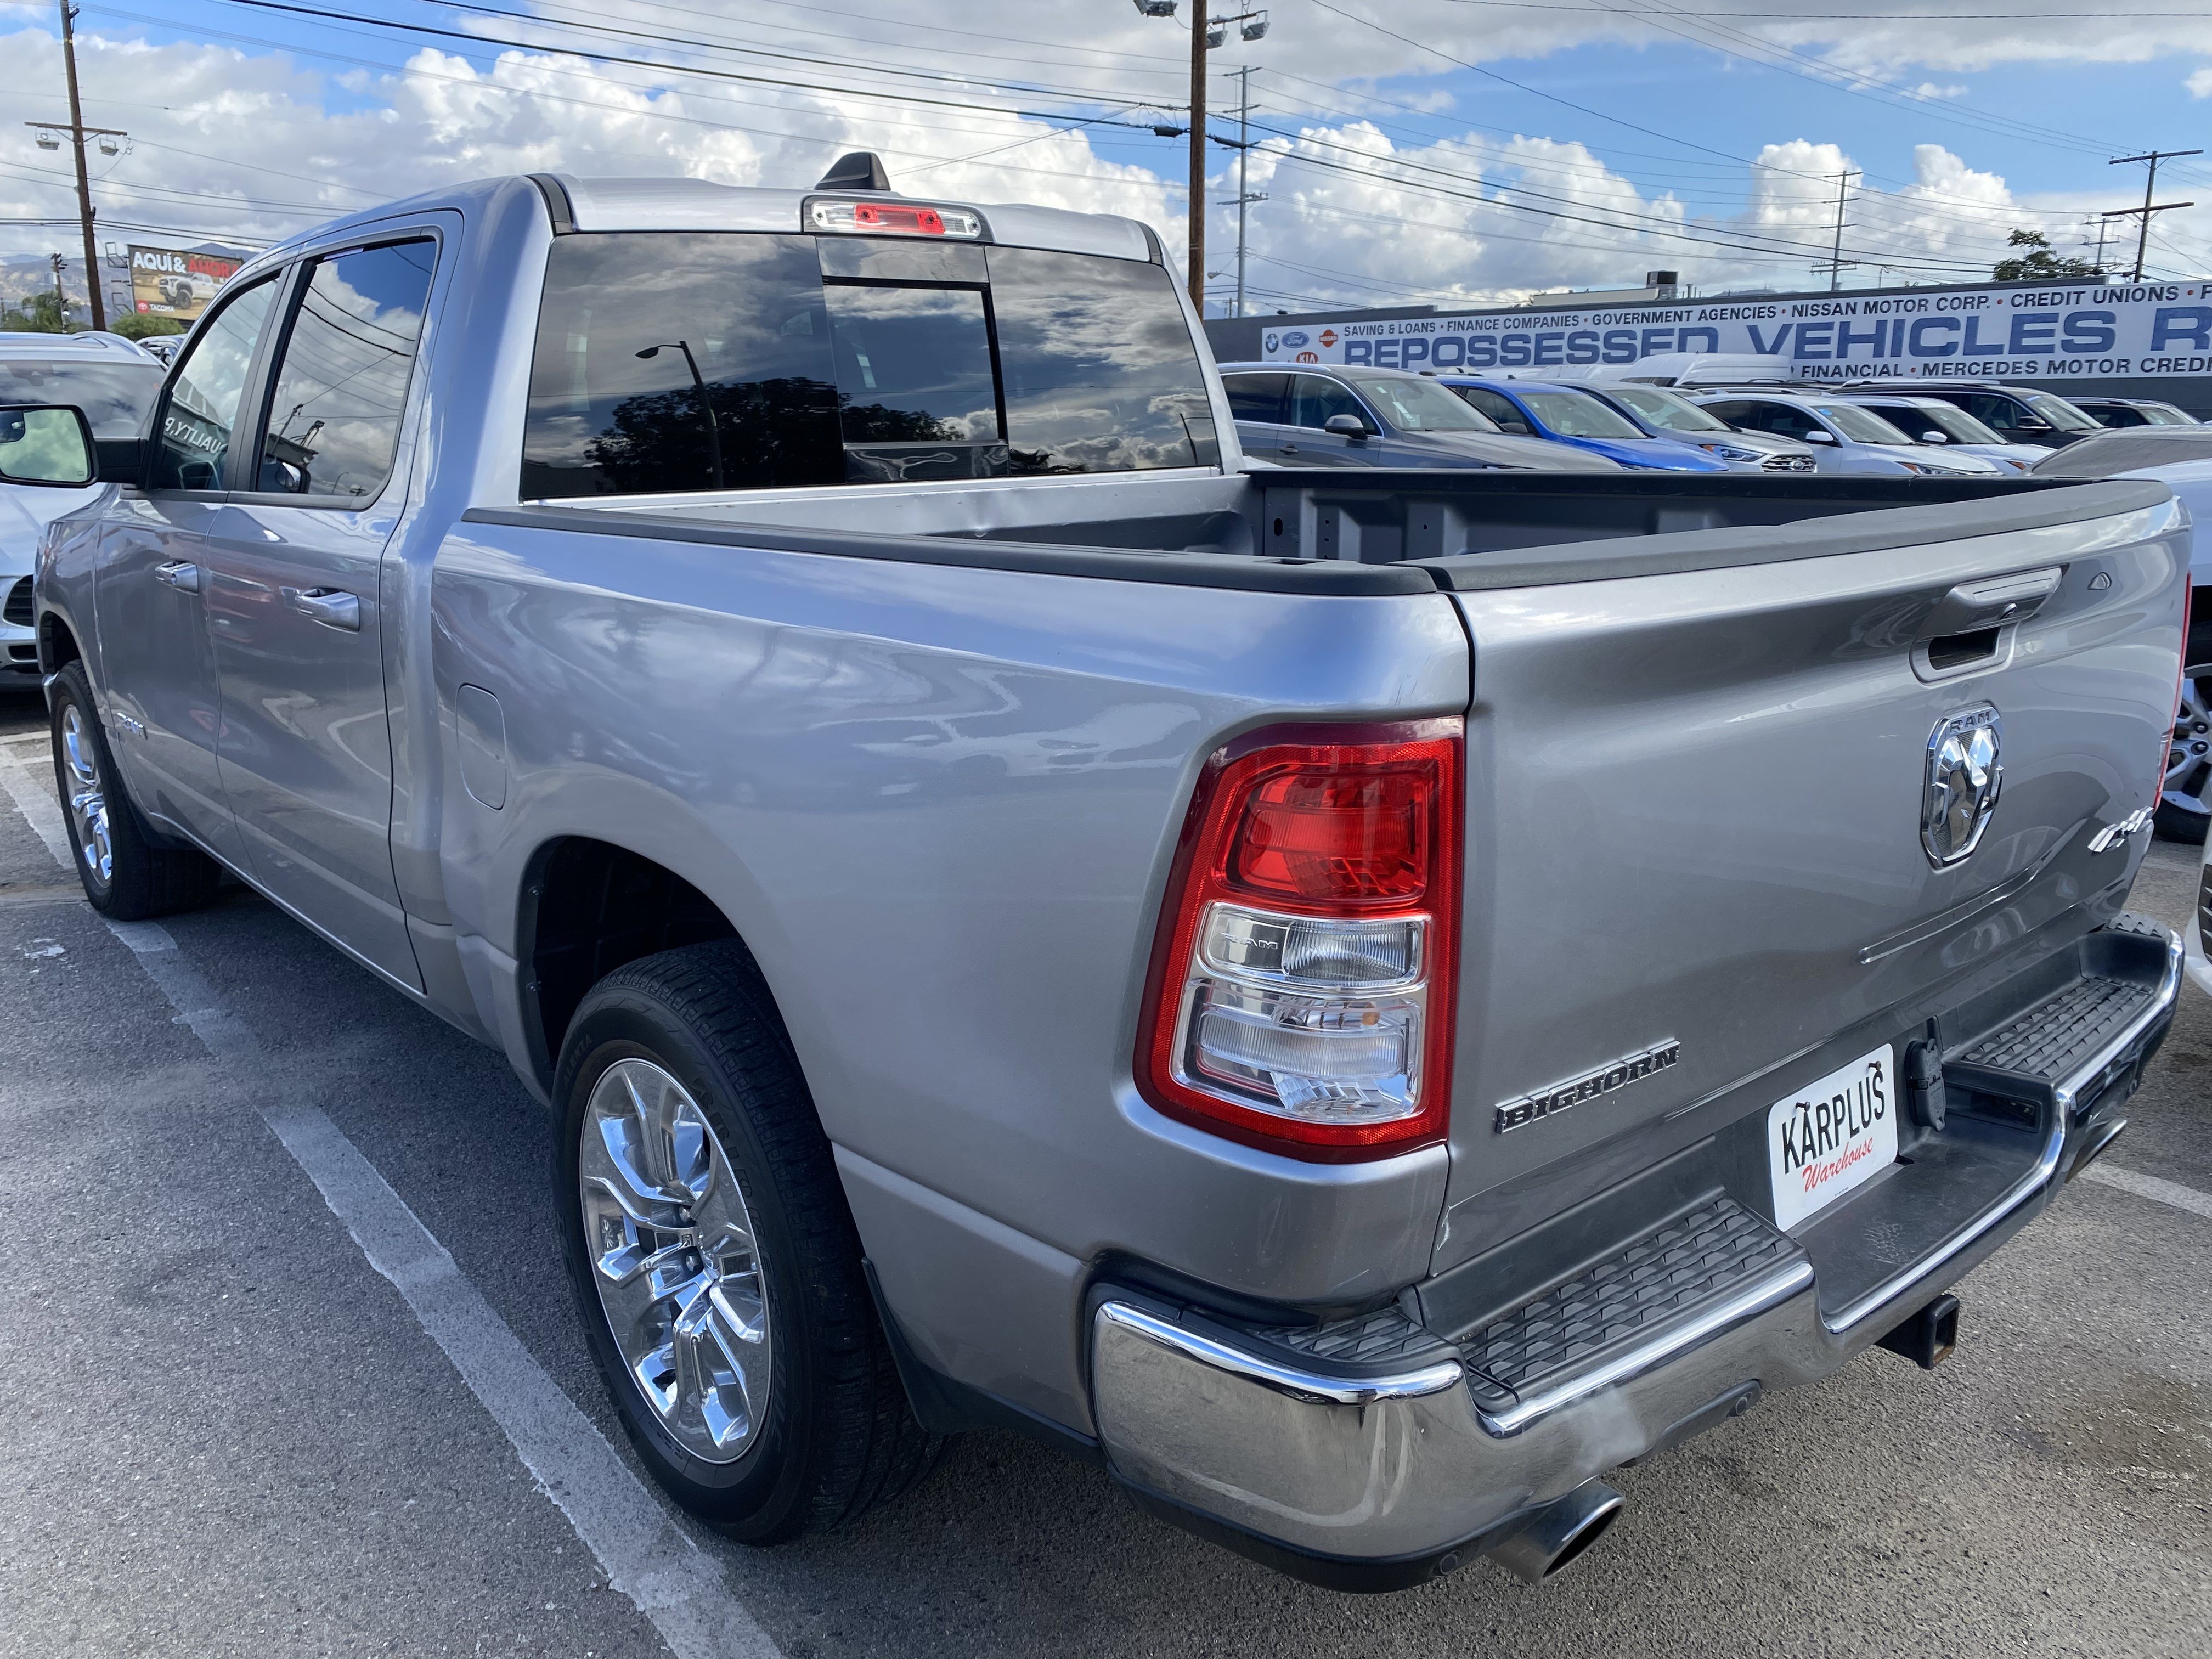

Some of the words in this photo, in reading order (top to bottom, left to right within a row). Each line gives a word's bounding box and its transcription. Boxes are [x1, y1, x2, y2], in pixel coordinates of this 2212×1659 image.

[133, 252, 172, 272] AQUÍ
[173, 257, 186, 273] &
[149, 303, 174, 312] TACOMA
[1344, 324, 1384, 337] SAVING
[1389, 324, 1395, 334] &
[1398, 322, 1436, 334] LOANS
[1447, 319, 1499, 332] FINANCE
[1503, 315, 1579, 329] COMPANIES
[1593, 310, 1693, 325] GOVERNMENT
[1698, 306, 1777, 321] AGENCIES
[1791, 302, 1858, 318] NISSAN
[1864, 298, 1929, 315] MOTOR
[1936, 296, 1990, 311] CORP.
[2011, 291, 2086, 307] CREDIT
[2094, 286, 2180, 304] UNIONS
[1344, 326, 1719, 369] REPOSSESSED
[1746, 311, 2117, 360] VEHICLES
[1801, 364, 1904, 378] FINANCIAL
[1922, 360, 2039, 376] MERCEDES
[2047, 359, 2132, 374] MOTOR
[1949, 710, 1993, 734] RAM
[1221, 932, 1278, 950] RAM
[1782, 1070, 1886, 1175] KARPLUS
[1802, 1137, 1874, 1193] Warehouse
[690, 1077, 788, 1454] BRIDGESTONE
